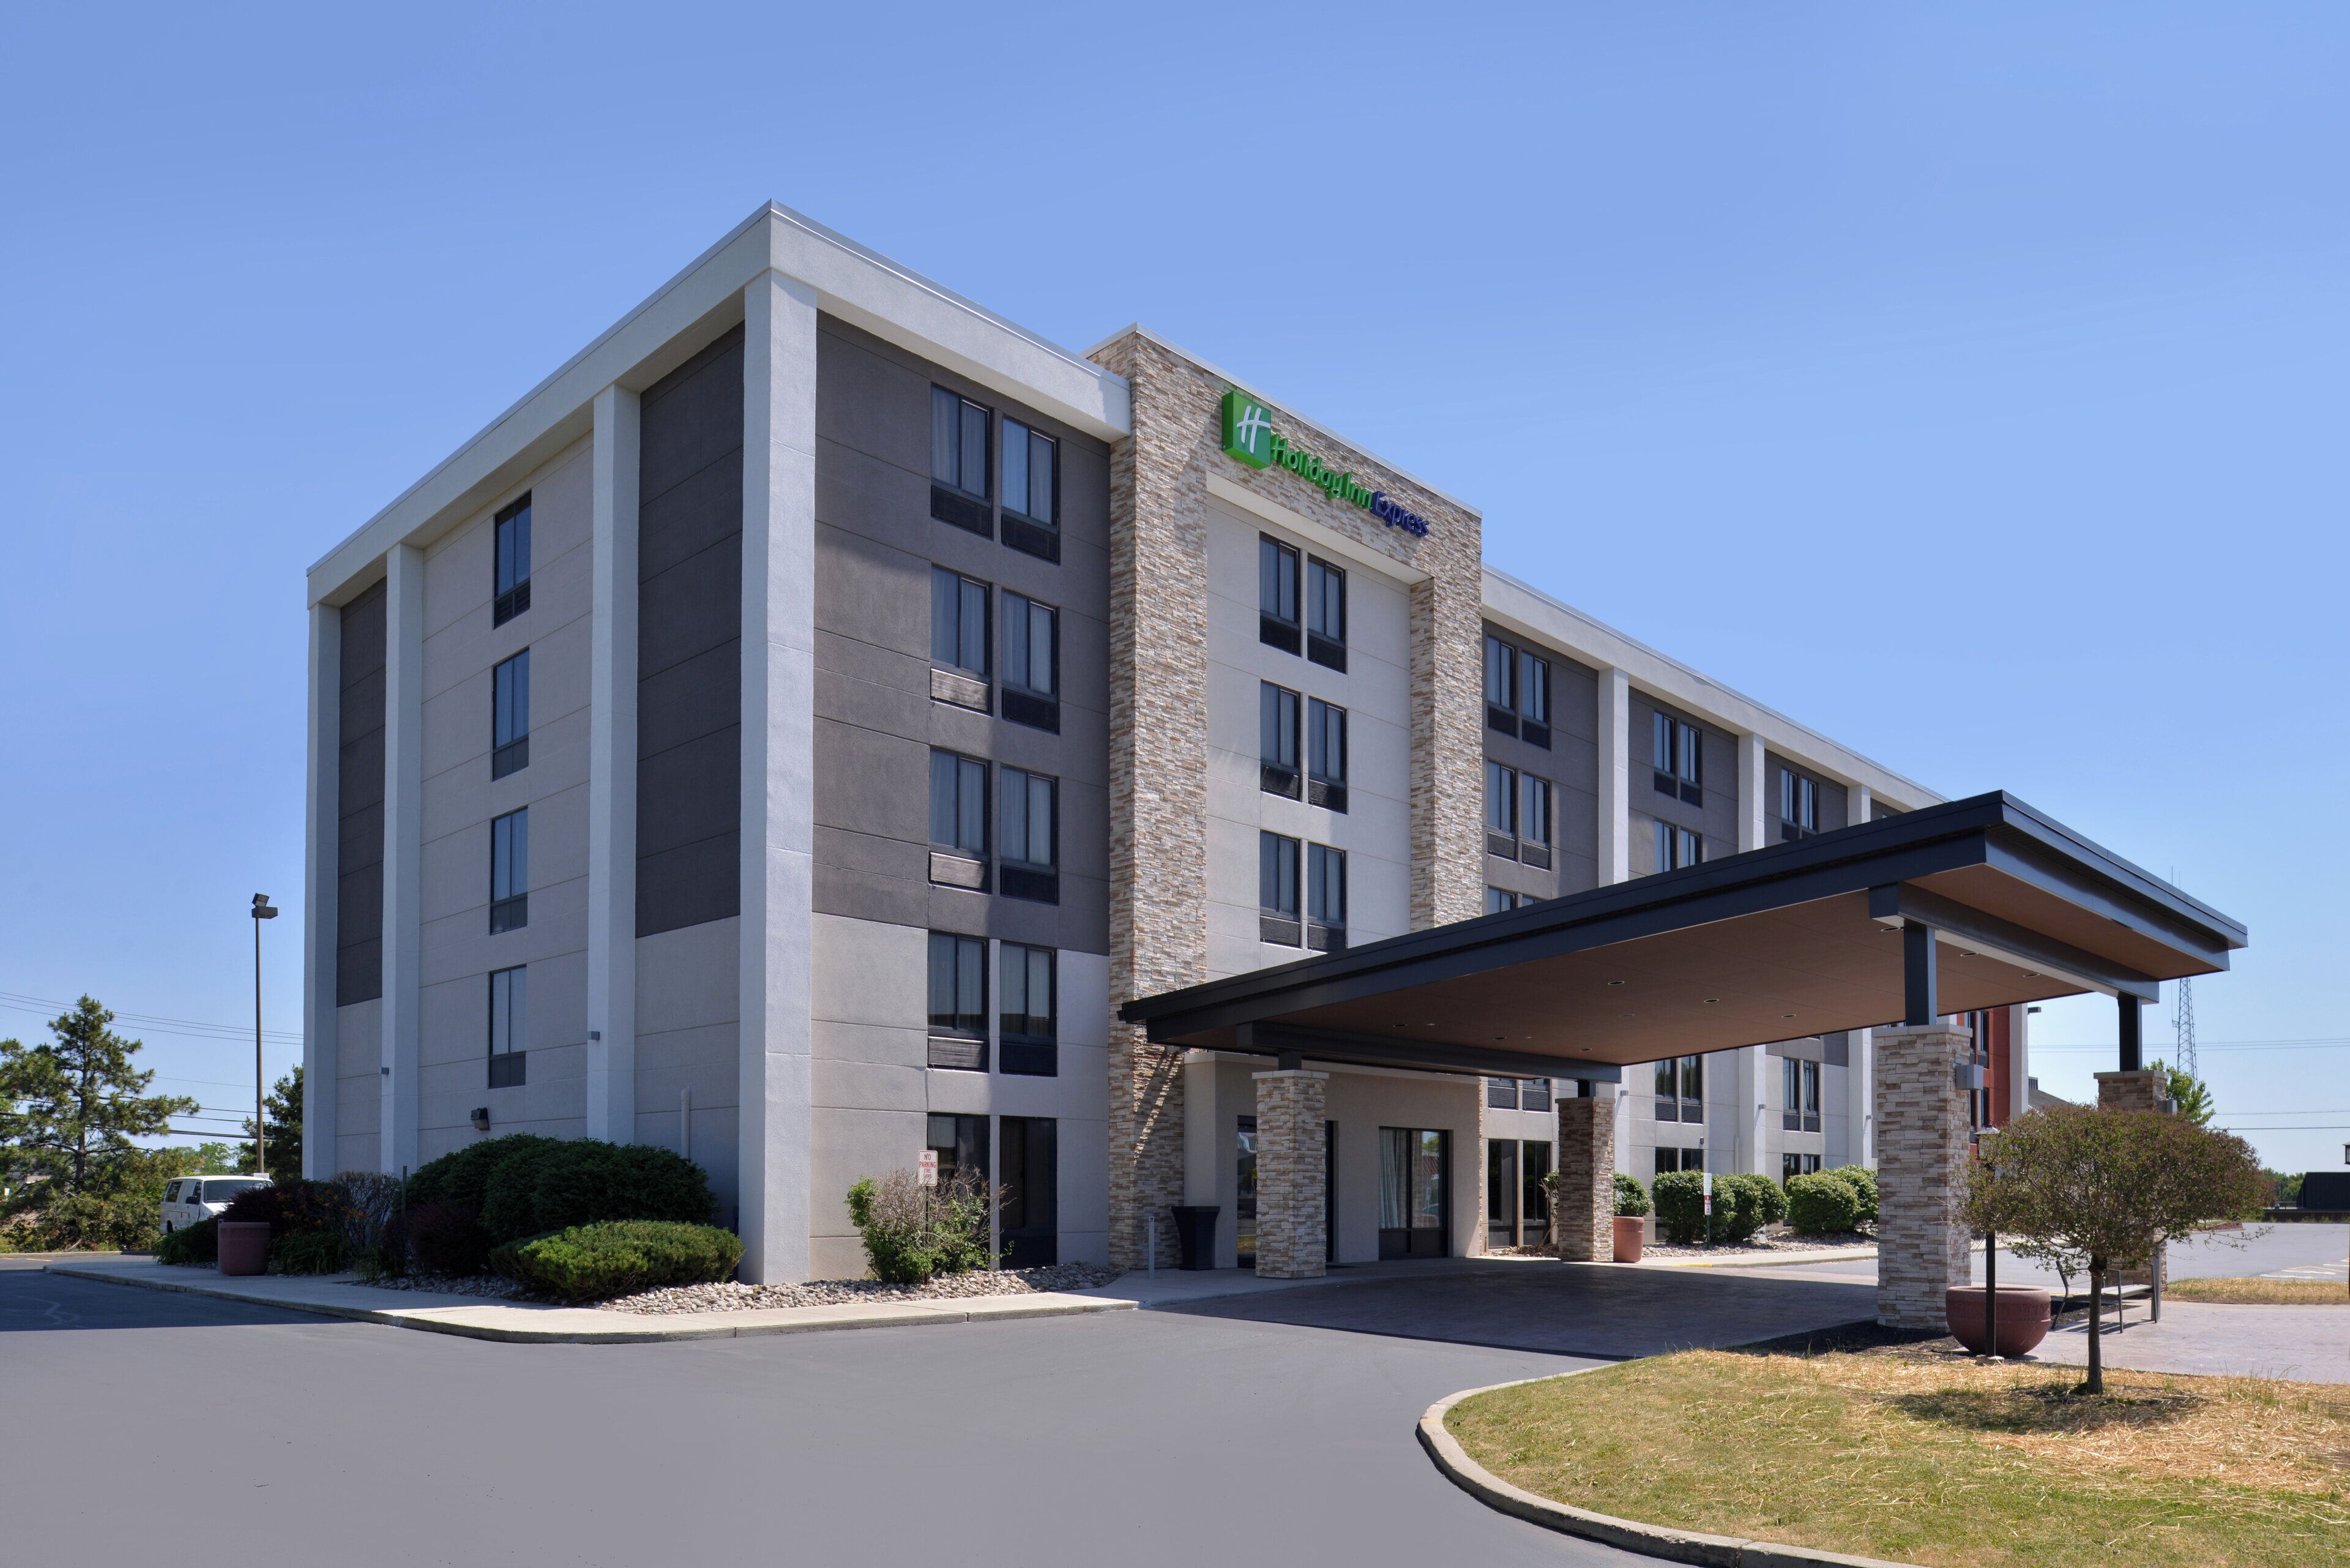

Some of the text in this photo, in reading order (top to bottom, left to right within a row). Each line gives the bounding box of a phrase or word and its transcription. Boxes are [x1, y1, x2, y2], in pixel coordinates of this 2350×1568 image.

[1270, 434, 1429, 537] Holiday Inn Express
